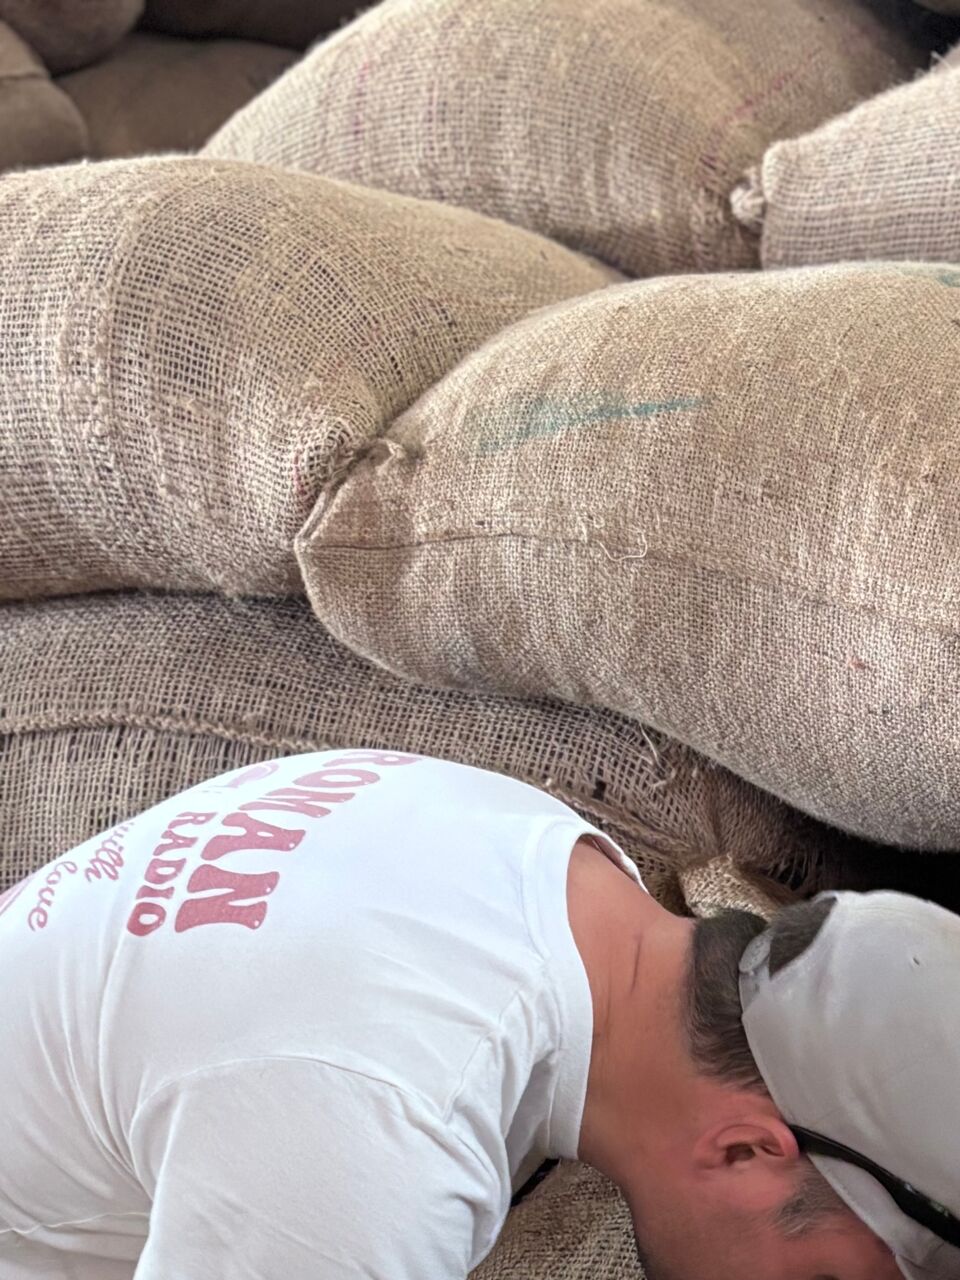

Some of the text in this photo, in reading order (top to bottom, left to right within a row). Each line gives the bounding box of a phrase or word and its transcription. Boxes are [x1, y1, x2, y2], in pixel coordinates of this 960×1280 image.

[28, 861, 78, 932] love
[128, 811, 218, 936] RADIO
[174, 751, 421, 933] ROMAN
